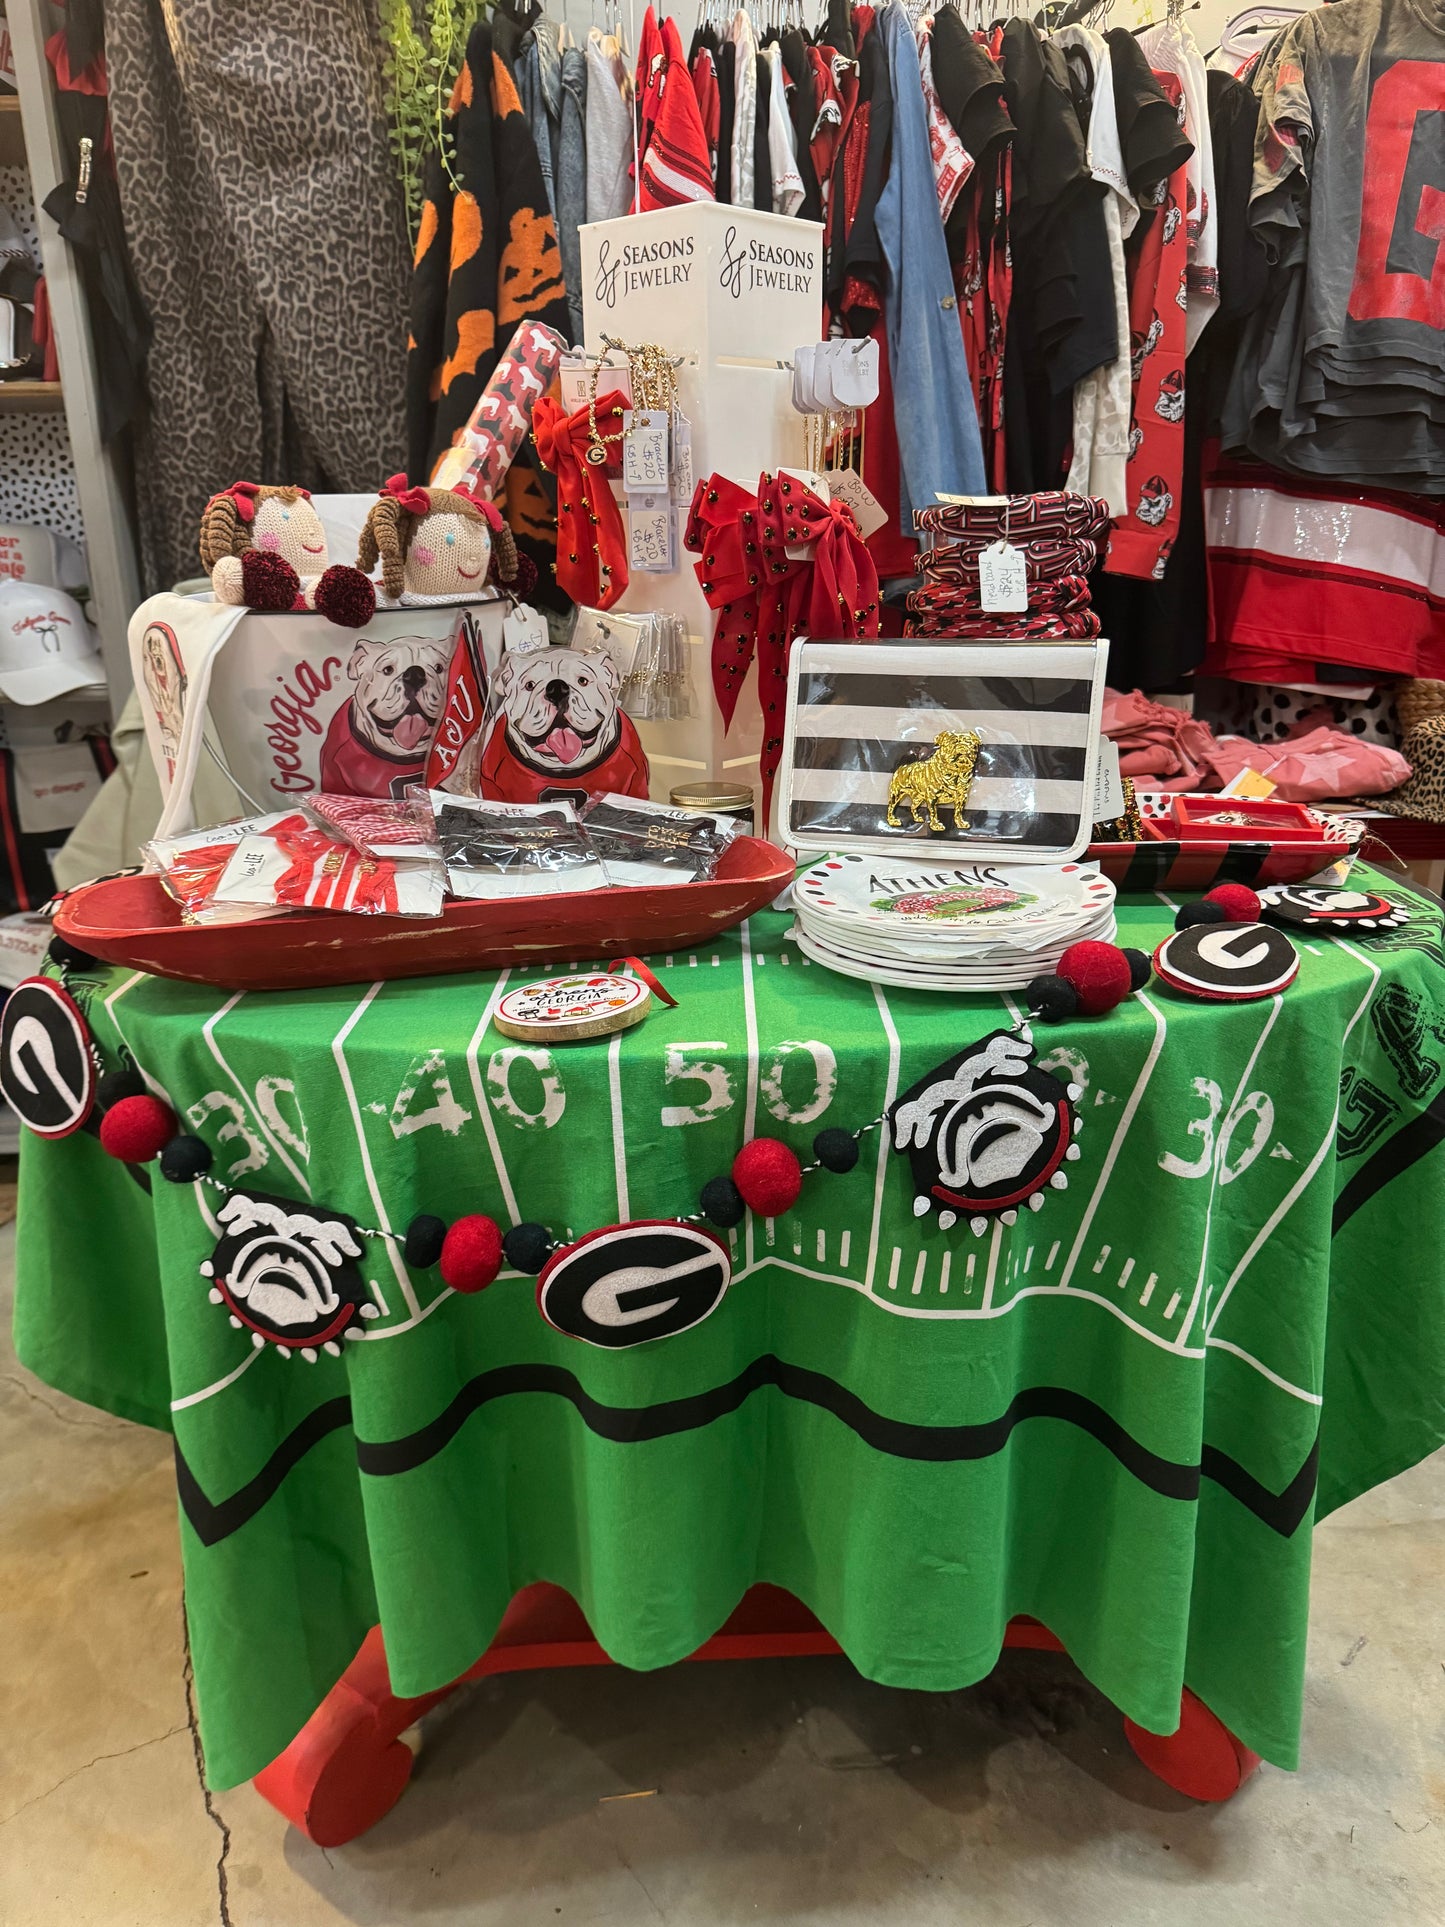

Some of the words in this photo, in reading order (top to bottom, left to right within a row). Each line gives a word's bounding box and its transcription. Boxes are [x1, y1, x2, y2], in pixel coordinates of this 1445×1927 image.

[623, 236, 694, 267] SEASONS
[749, 239, 814, 270] SEASONS
[623, 262, 692, 297] JEWELRY
[749, 264, 812, 293] JEWELRY
[270, 656, 342, 794] Georgia
[434, 675, 474, 770] UGA
[869, 865, 1010, 895] ATHENS
[528, 987, 613, 1003] athens
[536, 992, 602, 1006] GEORGIA
[389, 1047, 566, 1139] 40
[660, 1040, 838, 1126] 50
[1157, 1076, 1275, 1185] 30
